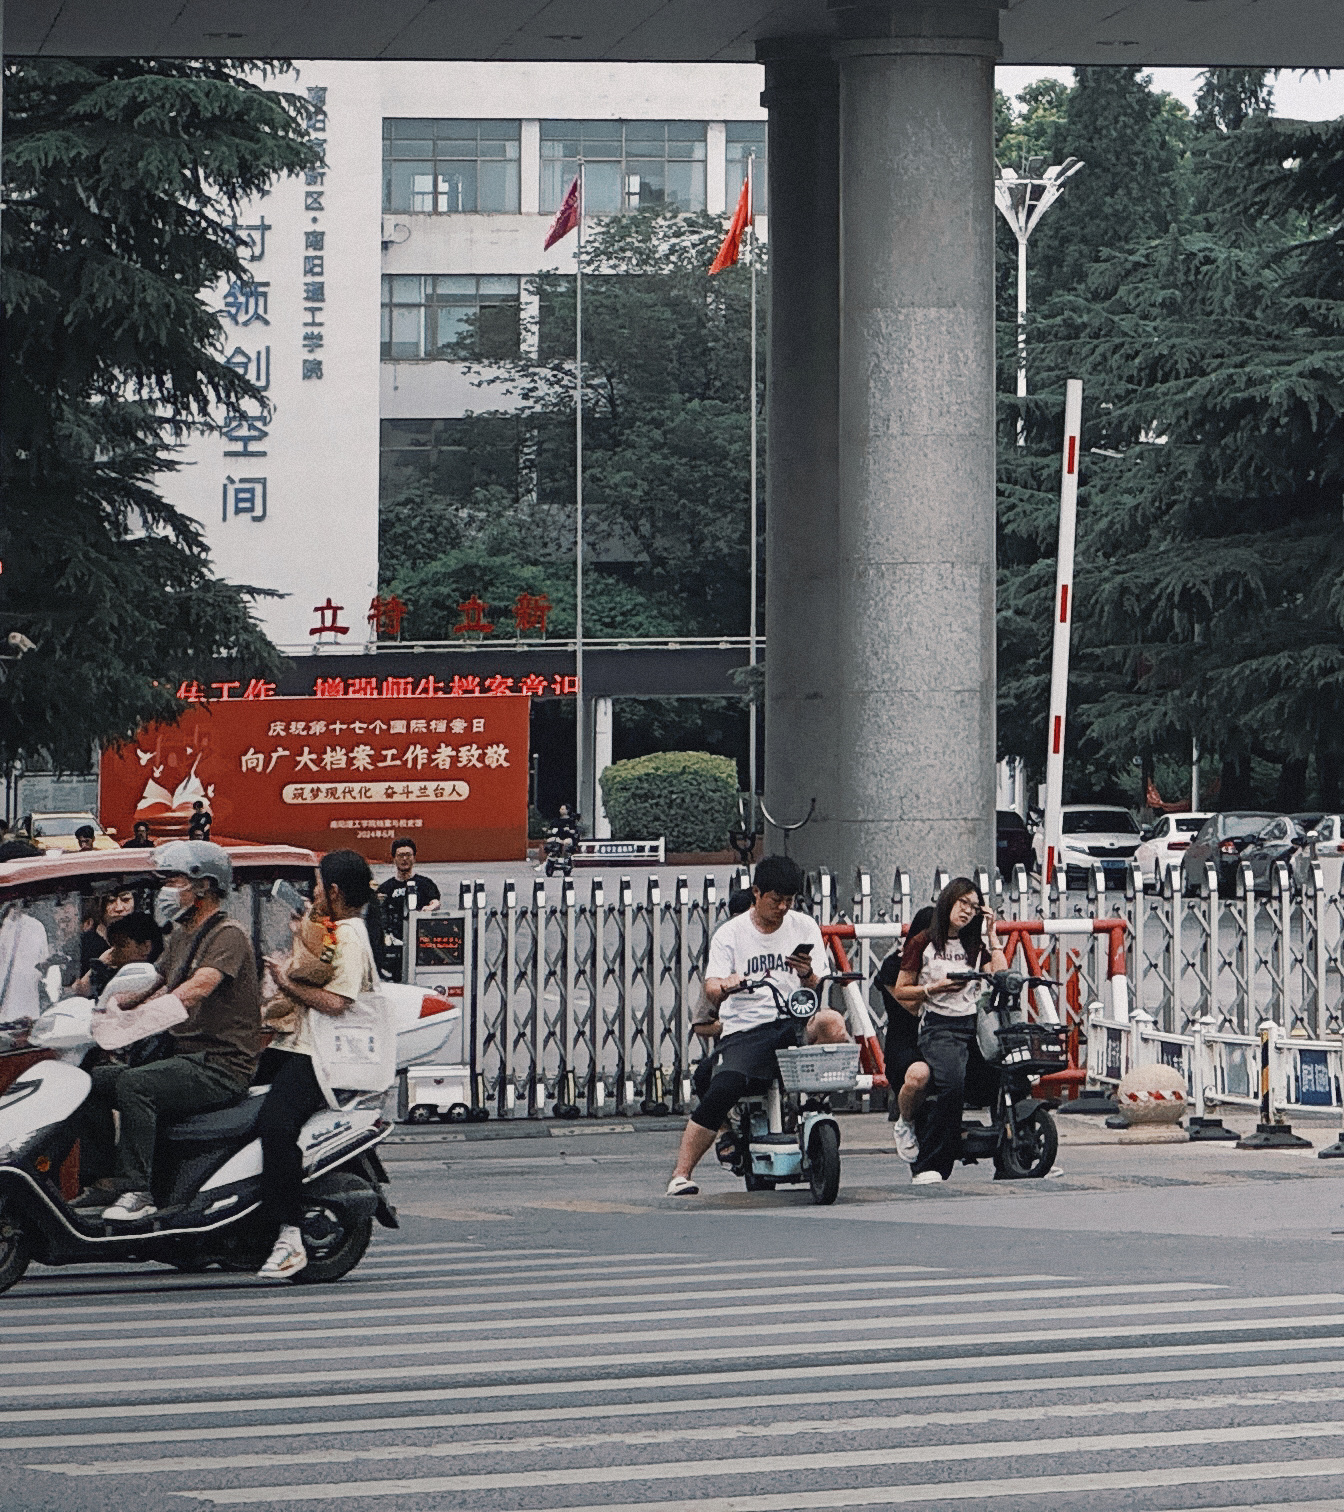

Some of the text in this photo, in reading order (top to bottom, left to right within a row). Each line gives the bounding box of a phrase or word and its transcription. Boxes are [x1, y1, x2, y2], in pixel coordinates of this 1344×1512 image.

[267, 718, 486, 737] 庆祝第十七个国际档案日
[240, 743, 511, 773] 向广大档案工作者致敬
[291, 784, 462, 801] 筑梦现代化 奋斗兰台人
